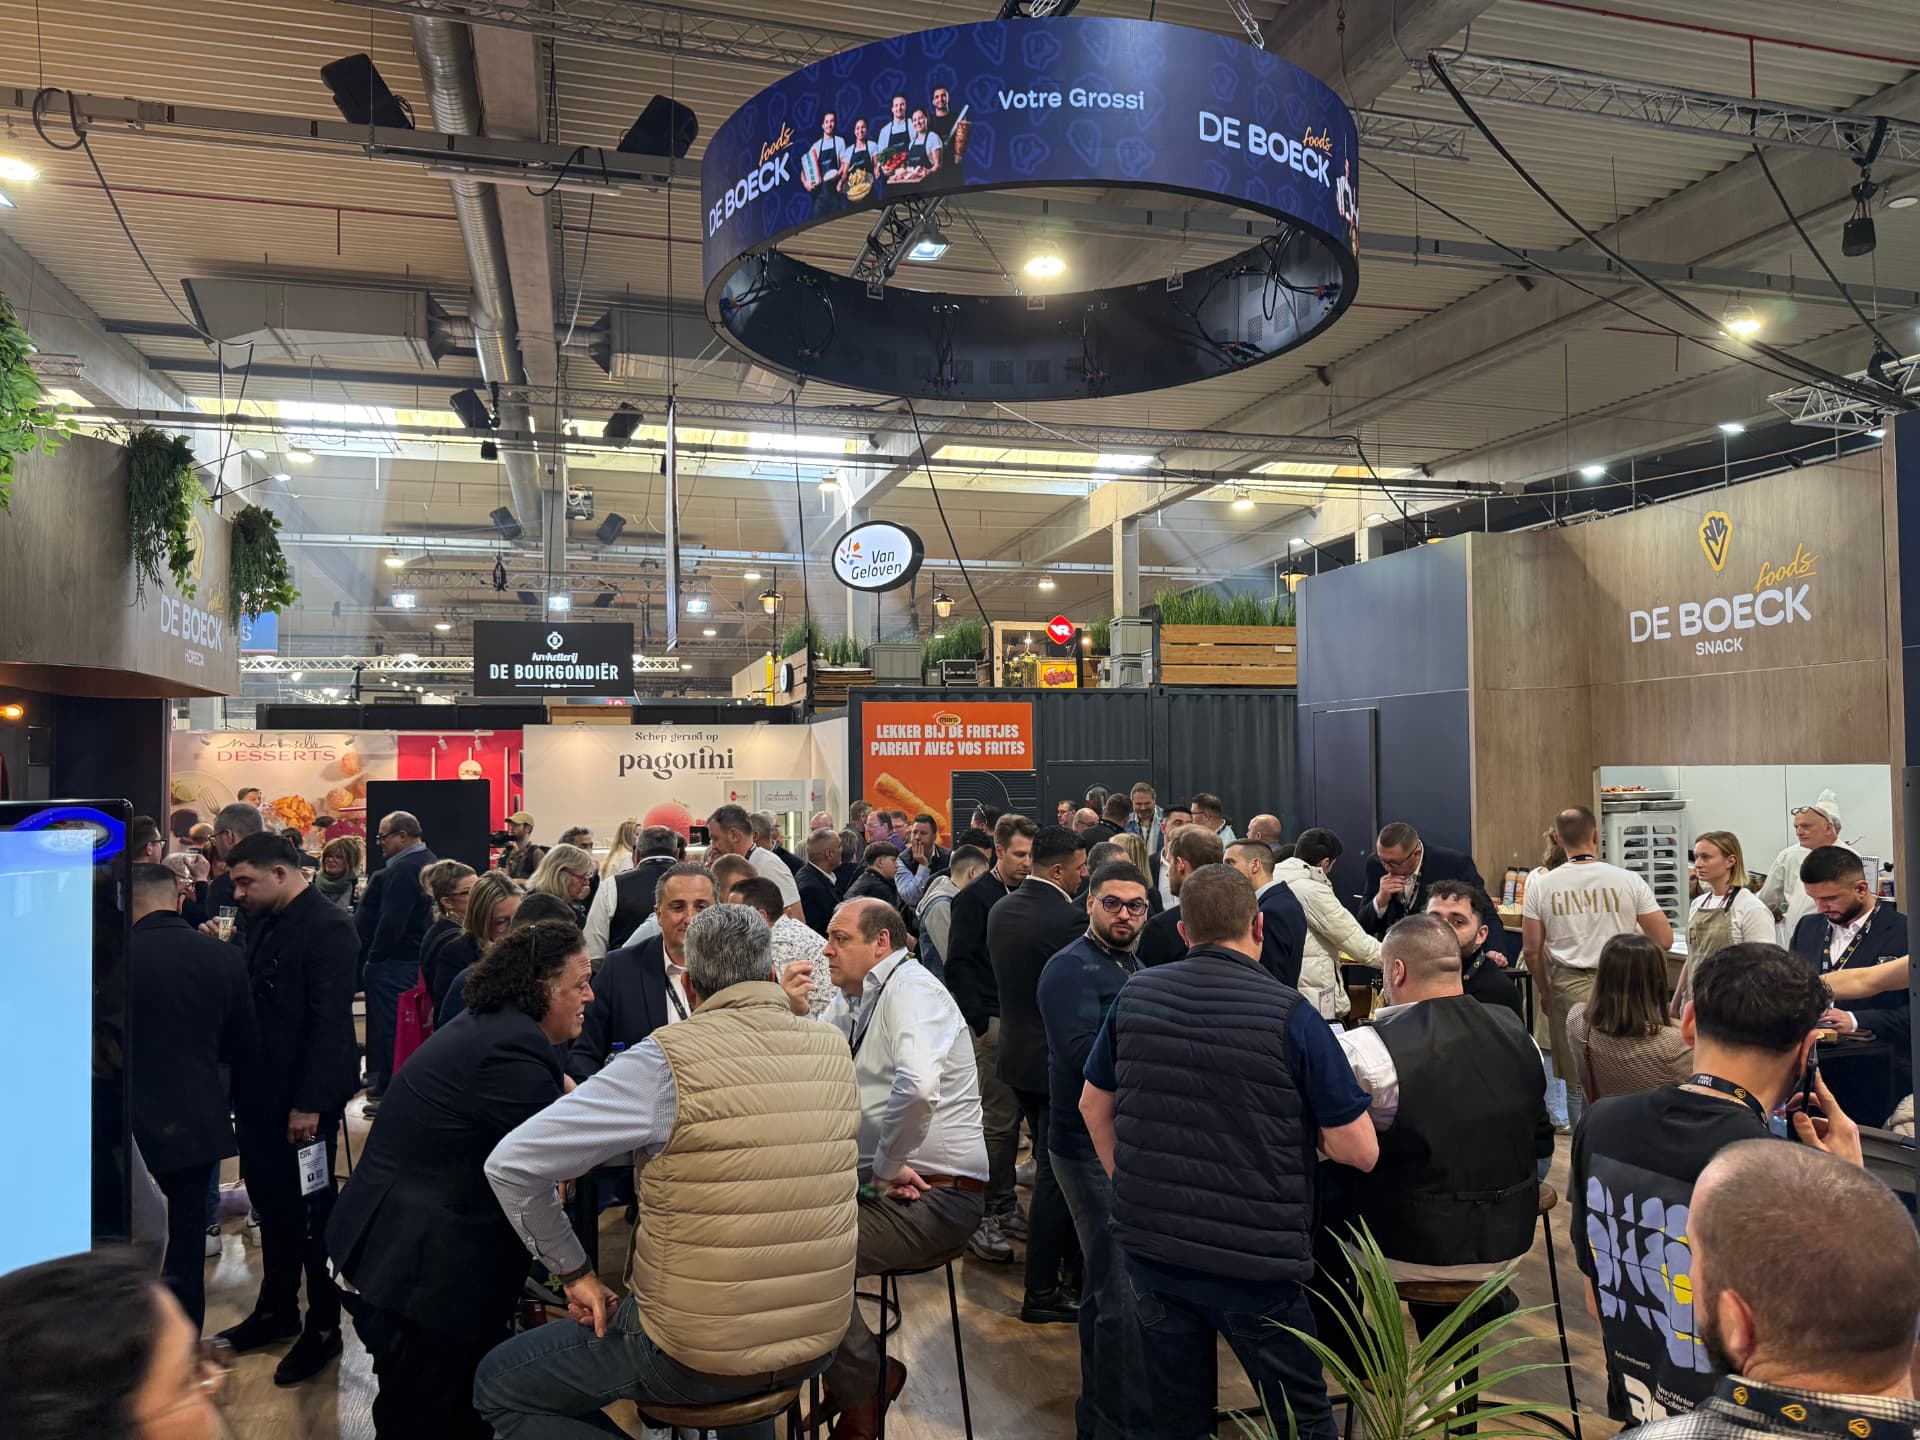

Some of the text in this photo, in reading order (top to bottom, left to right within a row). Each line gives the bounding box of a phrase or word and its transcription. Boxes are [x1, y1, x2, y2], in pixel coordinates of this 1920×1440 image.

[998, 88, 1145, 111] Votre Grossi
[759, 121, 794, 167] foods
[1199, 111, 1330, 189] DE BOECK
[1303, 126, 1333, 153] foods
[709, 152, 791, 238] DE BOECK
[872, 550, 895, 564] Van
[1753, 543, 1818, 592] foods
[851, 563, 902, 580] Geloven
[160, 594, 222, 652] DE BOECK
[1630, 584, 1812, 643] DE BOECK
[1695, 637, 1743, 656] SNACK
[489, 662, 619, 680] DE BOURGONDIËR
[635, 731, 719, 742] Schep gerust op
[876, 724, 1019, 738] LEKKER BIJ DE FRIETJES
[217, 750, 337, 762] DESSERTS
[871, 741, 1025, 756] PARFAIT AVEC VOS FRITES
[618, 745, 734, 780] pagotini
[1551, 887, 1621, 916] GINMAY
